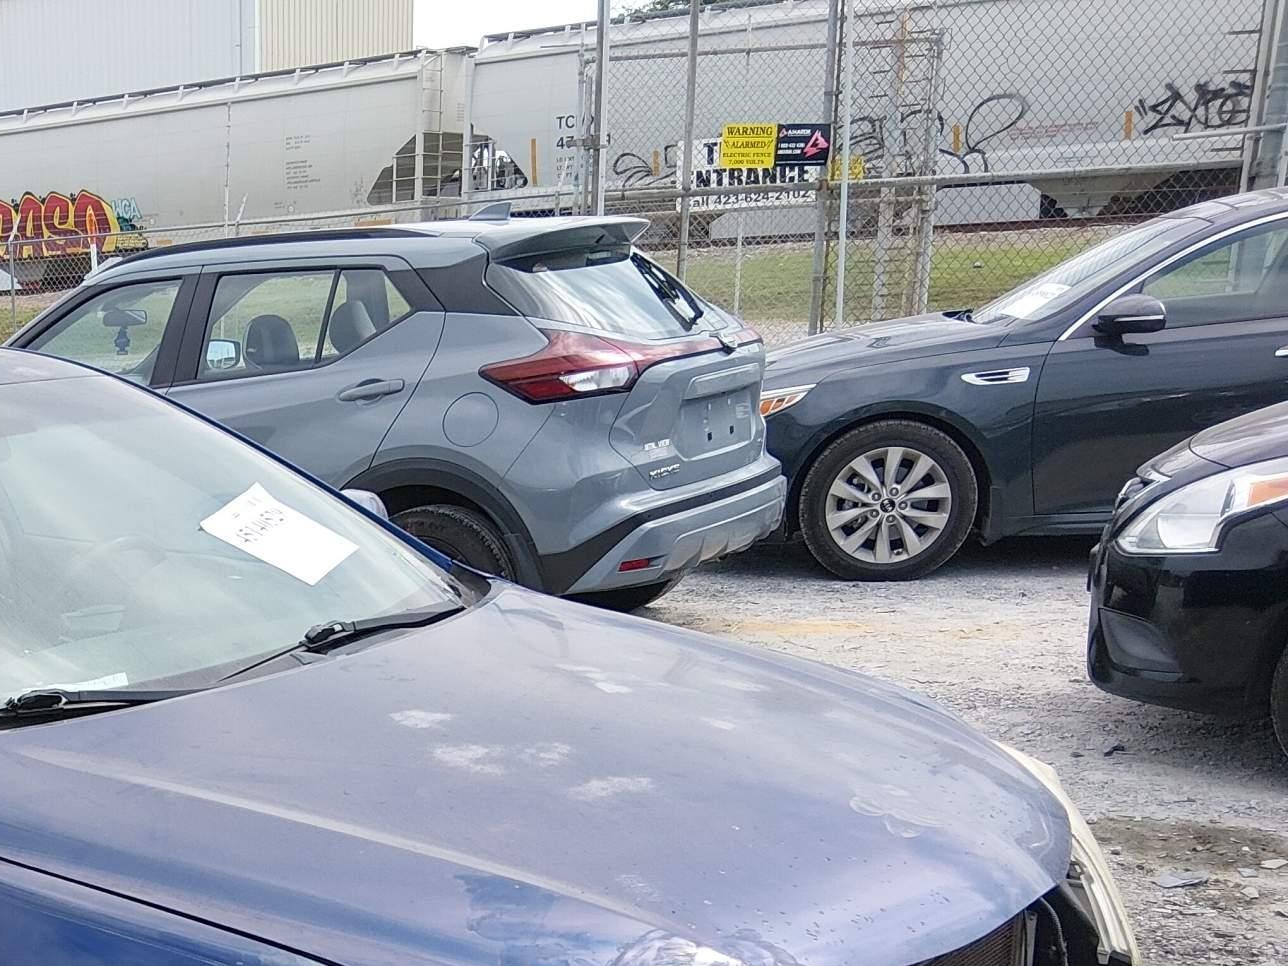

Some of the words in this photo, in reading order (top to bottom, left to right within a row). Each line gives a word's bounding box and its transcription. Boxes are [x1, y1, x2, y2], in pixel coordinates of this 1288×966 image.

[727, 126, 773, 137] WARNING
[730, 140, 766, 149] ALARMED
[690, 166, 810, 188] NTRANCE
